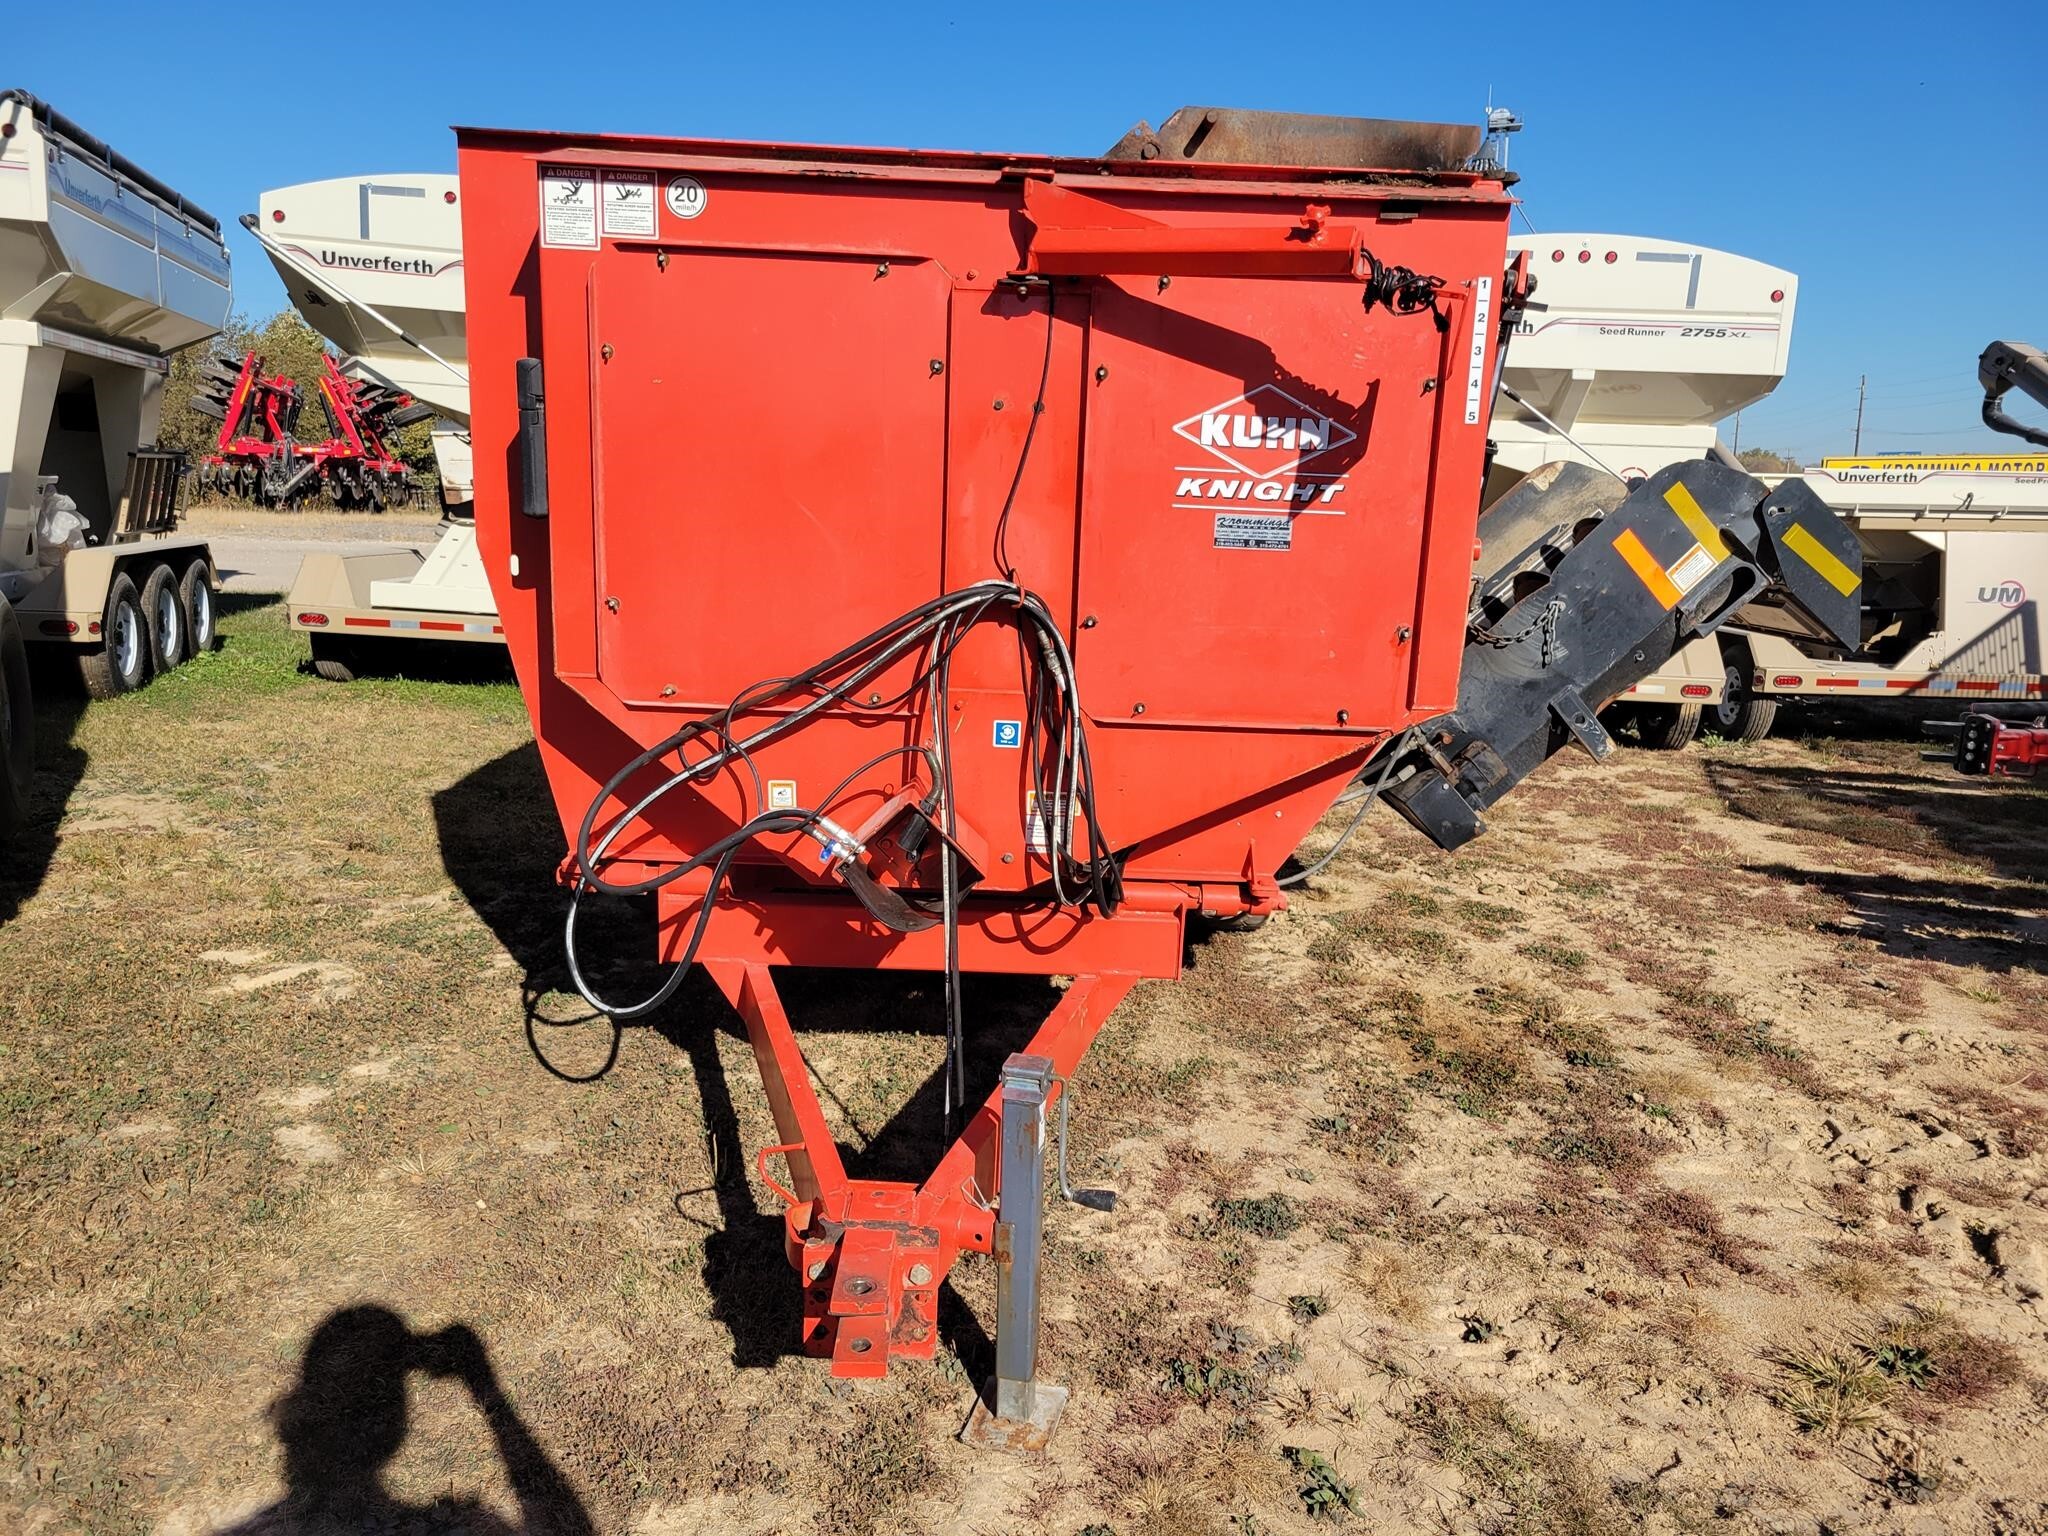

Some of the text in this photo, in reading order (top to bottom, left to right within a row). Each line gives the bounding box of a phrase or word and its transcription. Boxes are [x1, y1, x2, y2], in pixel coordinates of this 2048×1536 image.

[556, 169, 591, 178] DANGER
[616, 173, 648, 181] DANGER
[674, 185, 698, 203] 20
[321, 250, 434, 274] Unverferth
[1481, 280, 1487, 289] 1
[1478, 313, 1486, 322] 2
[1474, 346, 1482, 356] 3
[1471, 379, 1479, 389] 4
[1468, 411, 1476, 421] 5
[1200, 413, 1331, 450] KUHN
[1837, 471, 1918, 483] Unverferth
[1175, 478, 1346, 503] KNIGHT
[1978, 587, 2022, 603] UM
